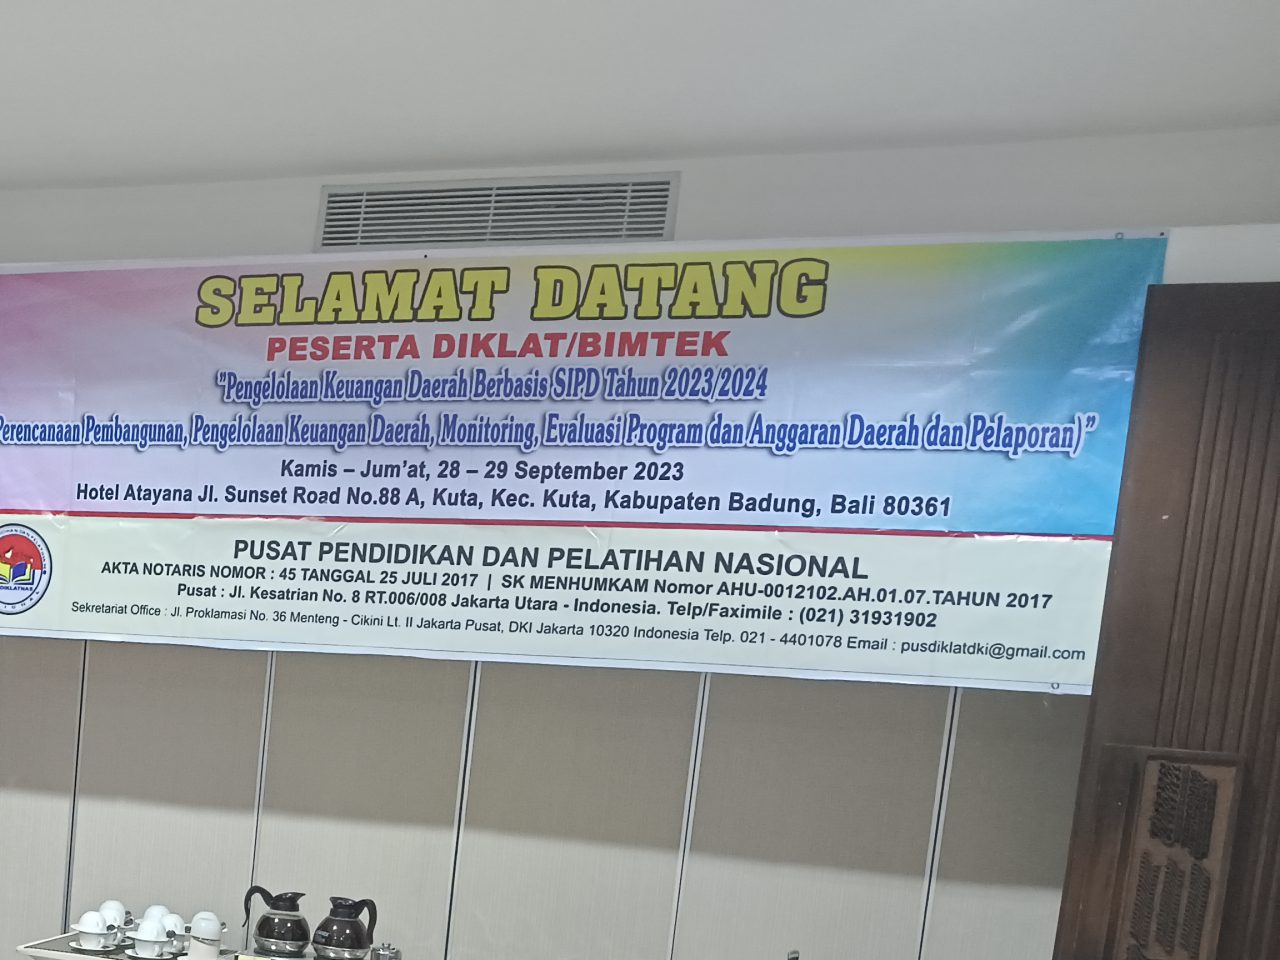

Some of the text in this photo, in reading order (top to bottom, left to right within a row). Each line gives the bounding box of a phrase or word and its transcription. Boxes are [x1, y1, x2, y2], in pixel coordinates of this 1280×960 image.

[195, 258, 829, 328] SELAMAT DATANG
[267, 331, 731, 361] PESERTA DIKLAT/BIMTEK
[323, 370, 402, 405] Keuangan
[408, 369, 467, 398] Daerah
[473, 368, 548, 398] Berbasis
[552, 367, 600, 398] SIPD
[606, 367, 658, 397] Tahun
[665, 367, 768, 400] 2023/2024
[85, 415, 187, 449] Pembangunan,
[193, 415, 283, 449] Pengelolaan
[288, 415, 366, 449] Keuangan
[371, 414, 434, 446] Daerah,
[441, 414, 540, 450] Monitoring,
[545, 413, 620, 444] Evaluasi
[626, 413, 703, 451] Program
[709, 413, 743, 444] dan
[749, 413, 841, 452] Anggaran
[847, 414, 919, 446] Daerah
[926, 414, 963, 447] dan
[280, 459, 337, 477] Kamis
[437, 461, 460, 478] 28
[484, 461, 508, 479] 29
[515, 461, 627, 483] September
[633, 461, 684, 481] 2023
[76, 483, 119, 501] Hotel
[123, 484, 193, 505] Atayana
[224, 485, 287, 503] Sunset
[293, 487, 340, 504] Road
[347, 487, 400, 505] No.88
[405, 488, 425, 509] A,
[432, 488, 483, 509] Kuta,
[491, 489, 535, 508] Kec.
[543, 489, 596, 511] Kuta,
[604, 489, 720, 514] Kabupaten
[728, 492, 821, 518] Badung,
[830, 494, 875, 515] Bali
[883, 495, 951, 517] 80361
[233, 539, 869, 579] PUSAT PENDIDIKAN DAN PELATIHAN NASIONAL
[101, 561, 139, 575] AKTA
[143, 563, 206, 578] NOTARIS
[210, 565, 266, 580] NOMOR
[279, 567, 297, 581] 45
[301, 568, 375, 584] TANGGAL
[380, 571, 398, 584] 25
[402, 571, 437, 586] JULI
[442, 573, 478, 588] 2017
[501, 574, 525, 589] SK
[530, 575, 649, 593] MENHUMKAM
[654, 580, 713, 595] Nomor
[716, 581, 1000, 608] AHU-0012102.AH.01.07.TAHUN
[1006, 592, 1053, 609] 2017
[178, 584, 217, 598] Pusat
[250, 586, 318, 602] Kesatrian
[322, 589, 347, 603] No.
[351, 590, 360, 604] 8
[365, 590, 447, 607] RT.006/008
[451, 594, 509, 609] Jakarta
[514, 596, 558, 611] Utara
[573, 598, 661, 615] Indonesia.
[667, 601, 782, 620] Telp/Faximile
[799, 607, 844, 626] (021)
[849, 609, 937, 628] 31931902
[71, 602, 128, 615] Sekretariat
[130, 604, 161, 617] Office
[185, 607, 247, 621] Proklamasi
[249, 609, 268, 622] No.
[272, 610, 287, 622] 36
[289, 611, 340, 627] Menteng
[351, 614, 384, 627] Cikini
[416, 617, 461, 631] Jakarta
[465, 619, 504, 633] Pusat,
[508, 621, 532, 634] DKI
[536, 622, 584, 636] Jakarta
[589, 624, 629, 638] 10320
[633, 626, 699, 641] Indonesia
[704, 628, 735, 644] Telp.
[740, 631, 766, 644] 021
[779, 633, 842, 648] 4401078
[846, 636, 888, 651] Email
[900, 640, 1086, 661] pusdiklatdki@gmail.com
